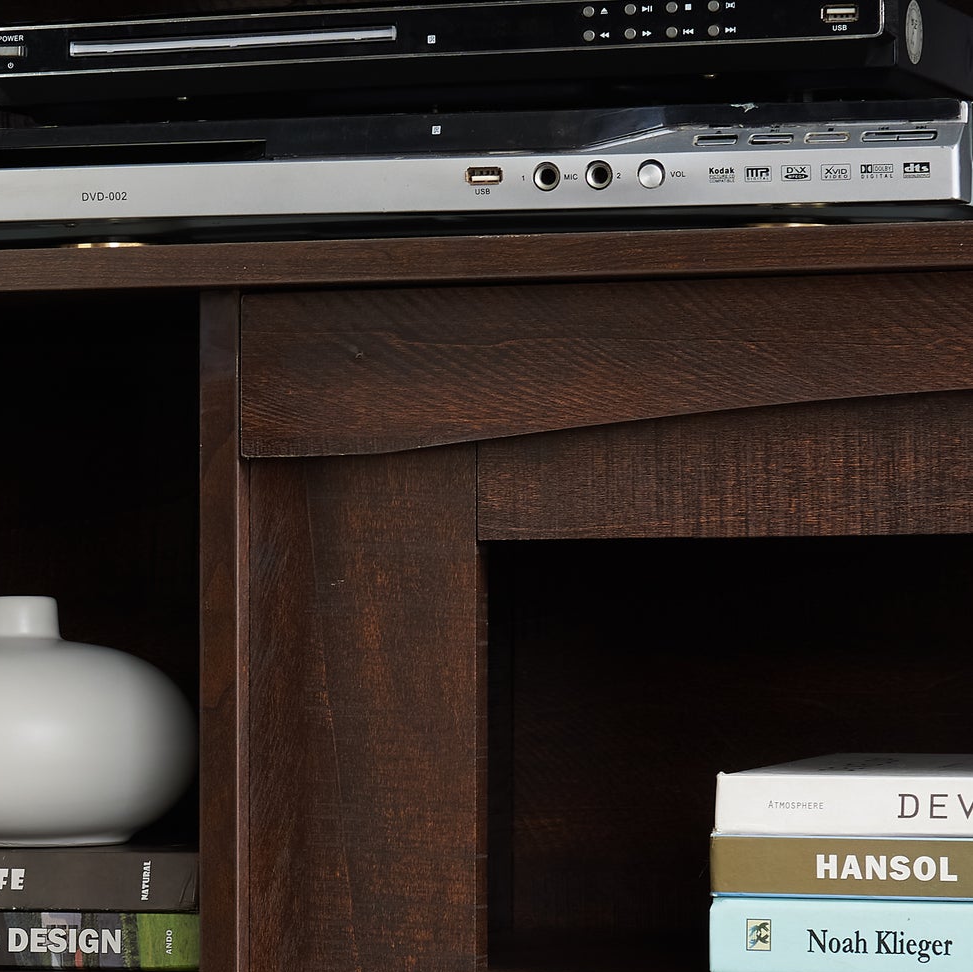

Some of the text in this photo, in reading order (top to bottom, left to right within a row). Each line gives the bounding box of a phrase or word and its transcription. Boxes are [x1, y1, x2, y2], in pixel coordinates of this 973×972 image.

[709, 167, 735, 175] Kodak
[904, 163, 929, 173] dts
[82, 192, 127, 201] DVD-002
[141, 860, 152, 901] NATURAL
[816, 854, 958, 882] HANSOL
[8, 927, 122, 954] DESIGN
[165, 929, 173, 955] ANDO
[807, 929, 953, 963] Noah Klieger
